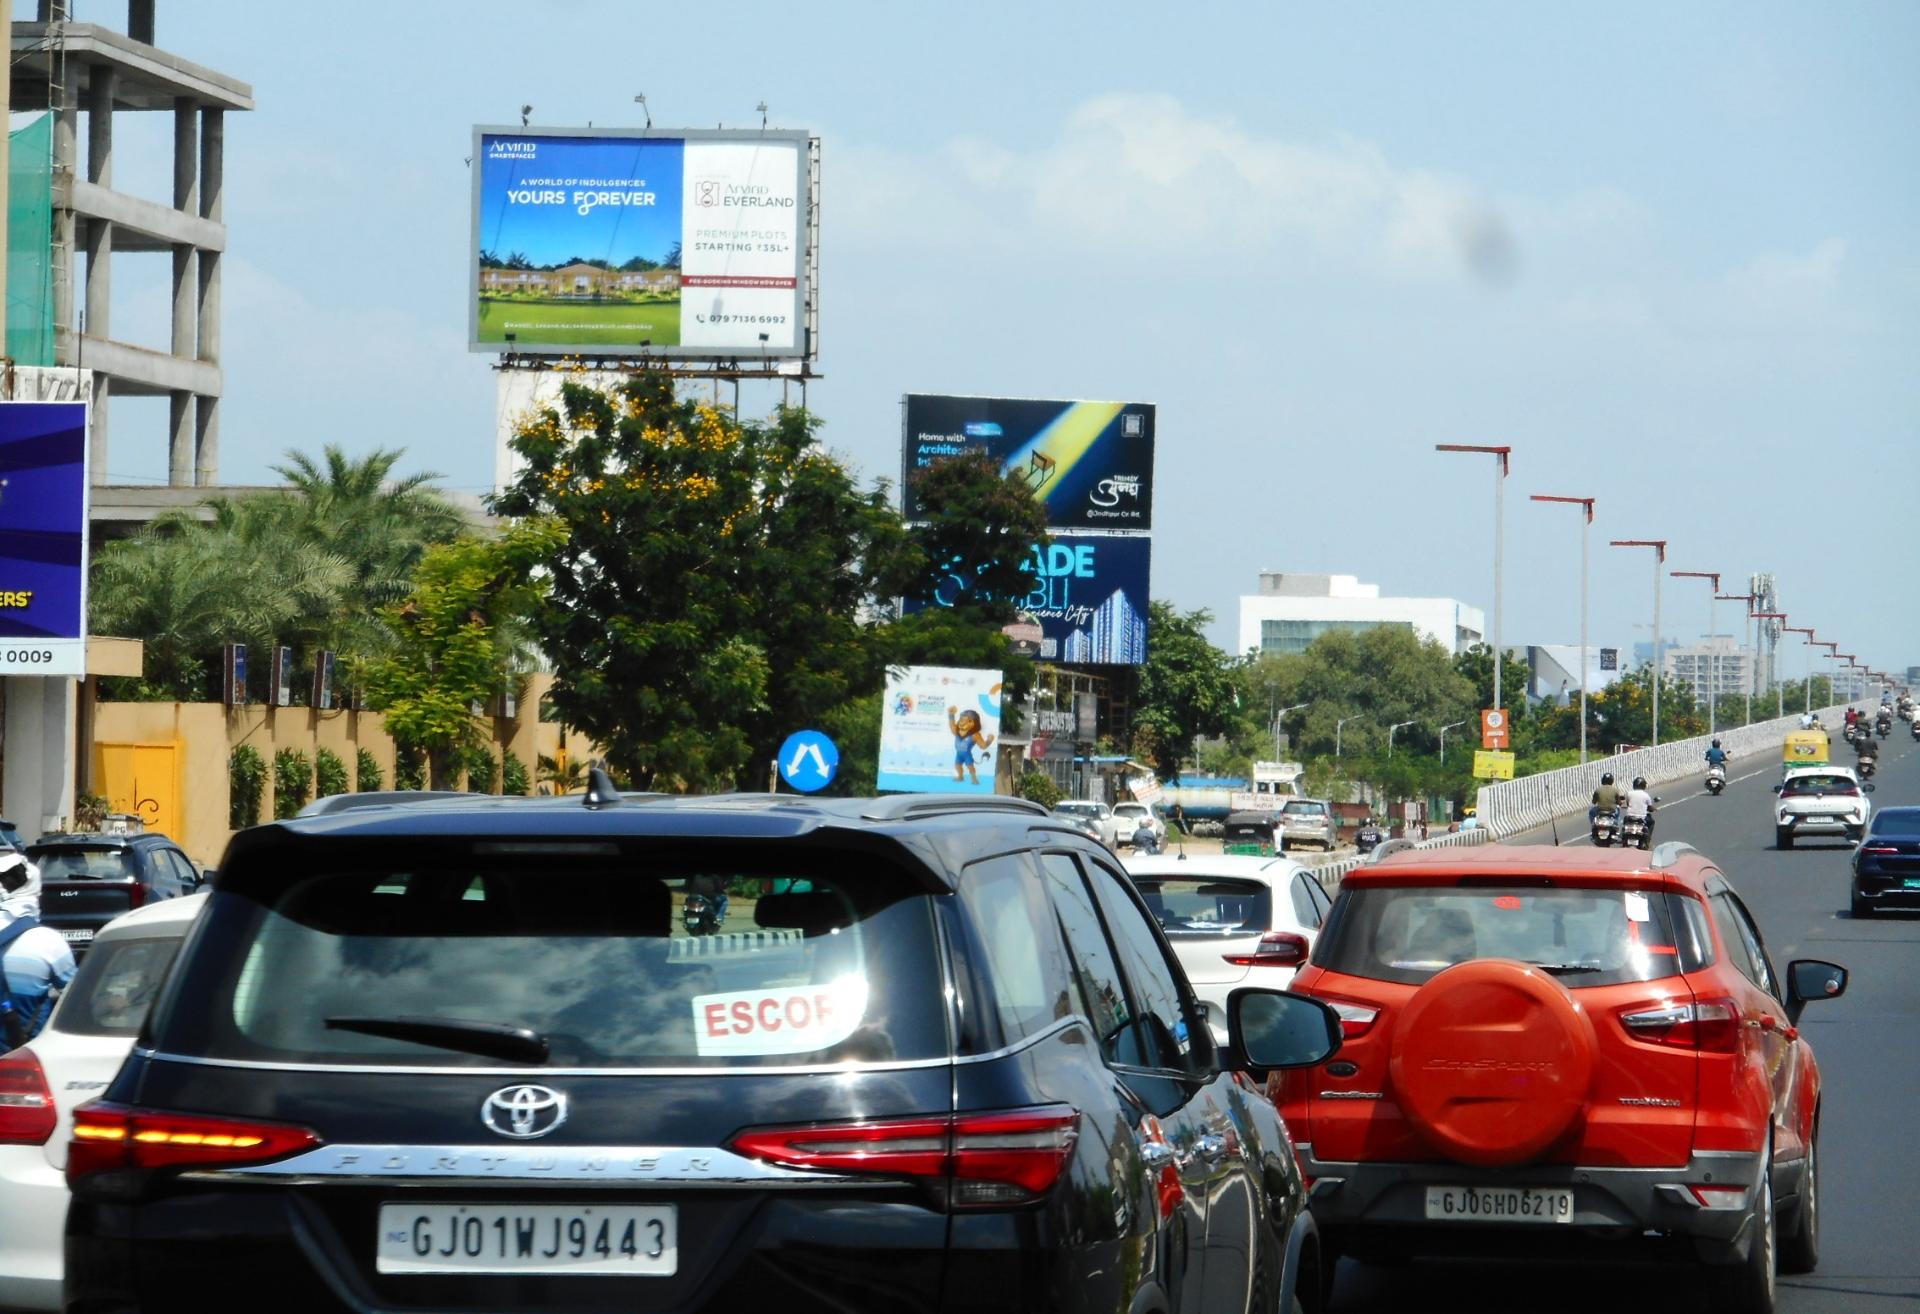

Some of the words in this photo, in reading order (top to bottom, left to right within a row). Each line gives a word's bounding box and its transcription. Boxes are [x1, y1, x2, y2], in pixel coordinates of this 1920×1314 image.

[579, 179, 645, 187] INDULGENCES
[507, 190, 566, 205] YOURS
[573, 190, 656, 215] FOREVER
[723, 196, 794, 207] EVERLAND
[696, 230, 748, 239] PREMIUM
[751, 230, 788, 239] PLOTS
[695, 243, 752, 251] STARTING
[710, 315, 730, 323] 079
[732, 315, 756, 323] 7136
[759, 315, 785, 324] 6992
[918, 432, 945, 442] Home
[946, 433, 966, 442] with
[7, 650, 52, 663] 0009
[335, 1155, 713, 1173] FORTUNER
[1443, 1191, 1569, 1216] GJ06HD6219
[412, 1215, 665, 1259] GJ01WJ9443
